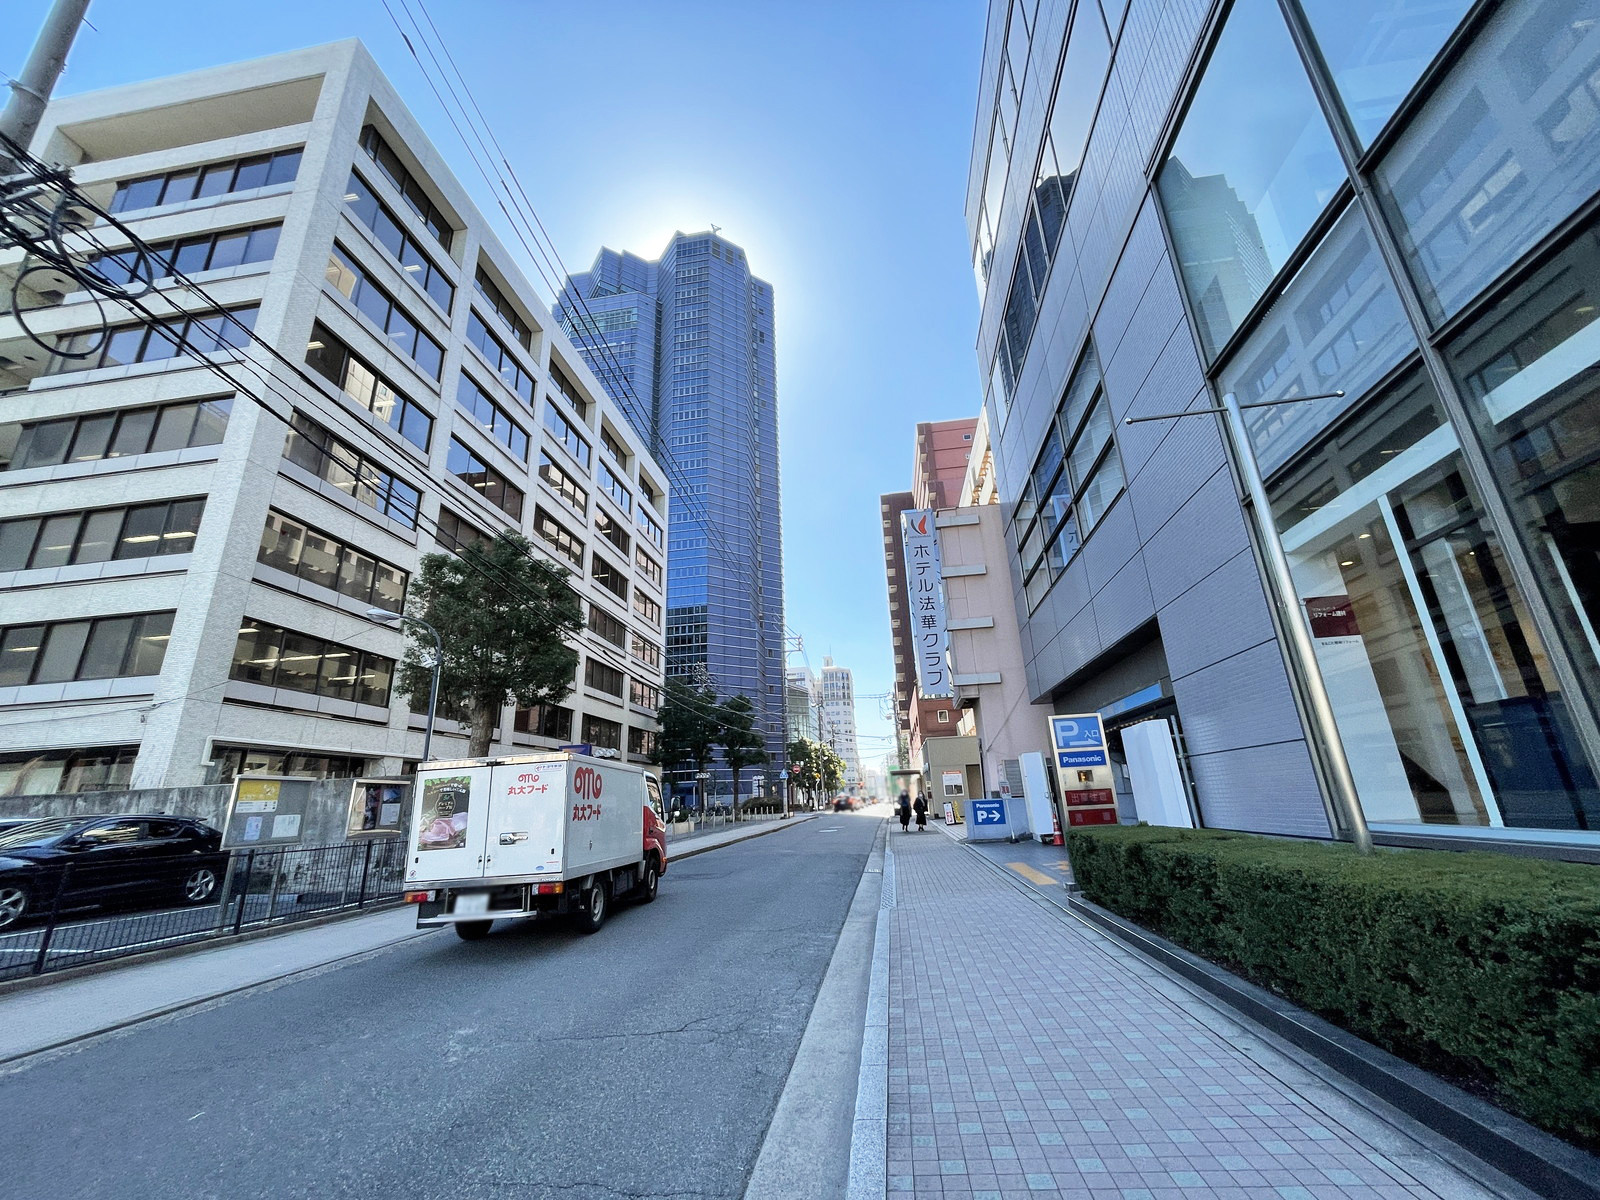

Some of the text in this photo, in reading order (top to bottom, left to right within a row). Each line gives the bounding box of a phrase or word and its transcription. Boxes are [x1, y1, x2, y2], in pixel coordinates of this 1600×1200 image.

[914, 544, 943, 686] ホテル法華クラブ
[1054, 720, 1079, 747] P
[1084, 729, 1100, 738] 入口
[1062, 754, 1102, 764] Panasonic
[507, 783, 549, 795] 丸大フード
[572, 803, 602, 821] 丸大フード
[977, 811, 988, 822] P
